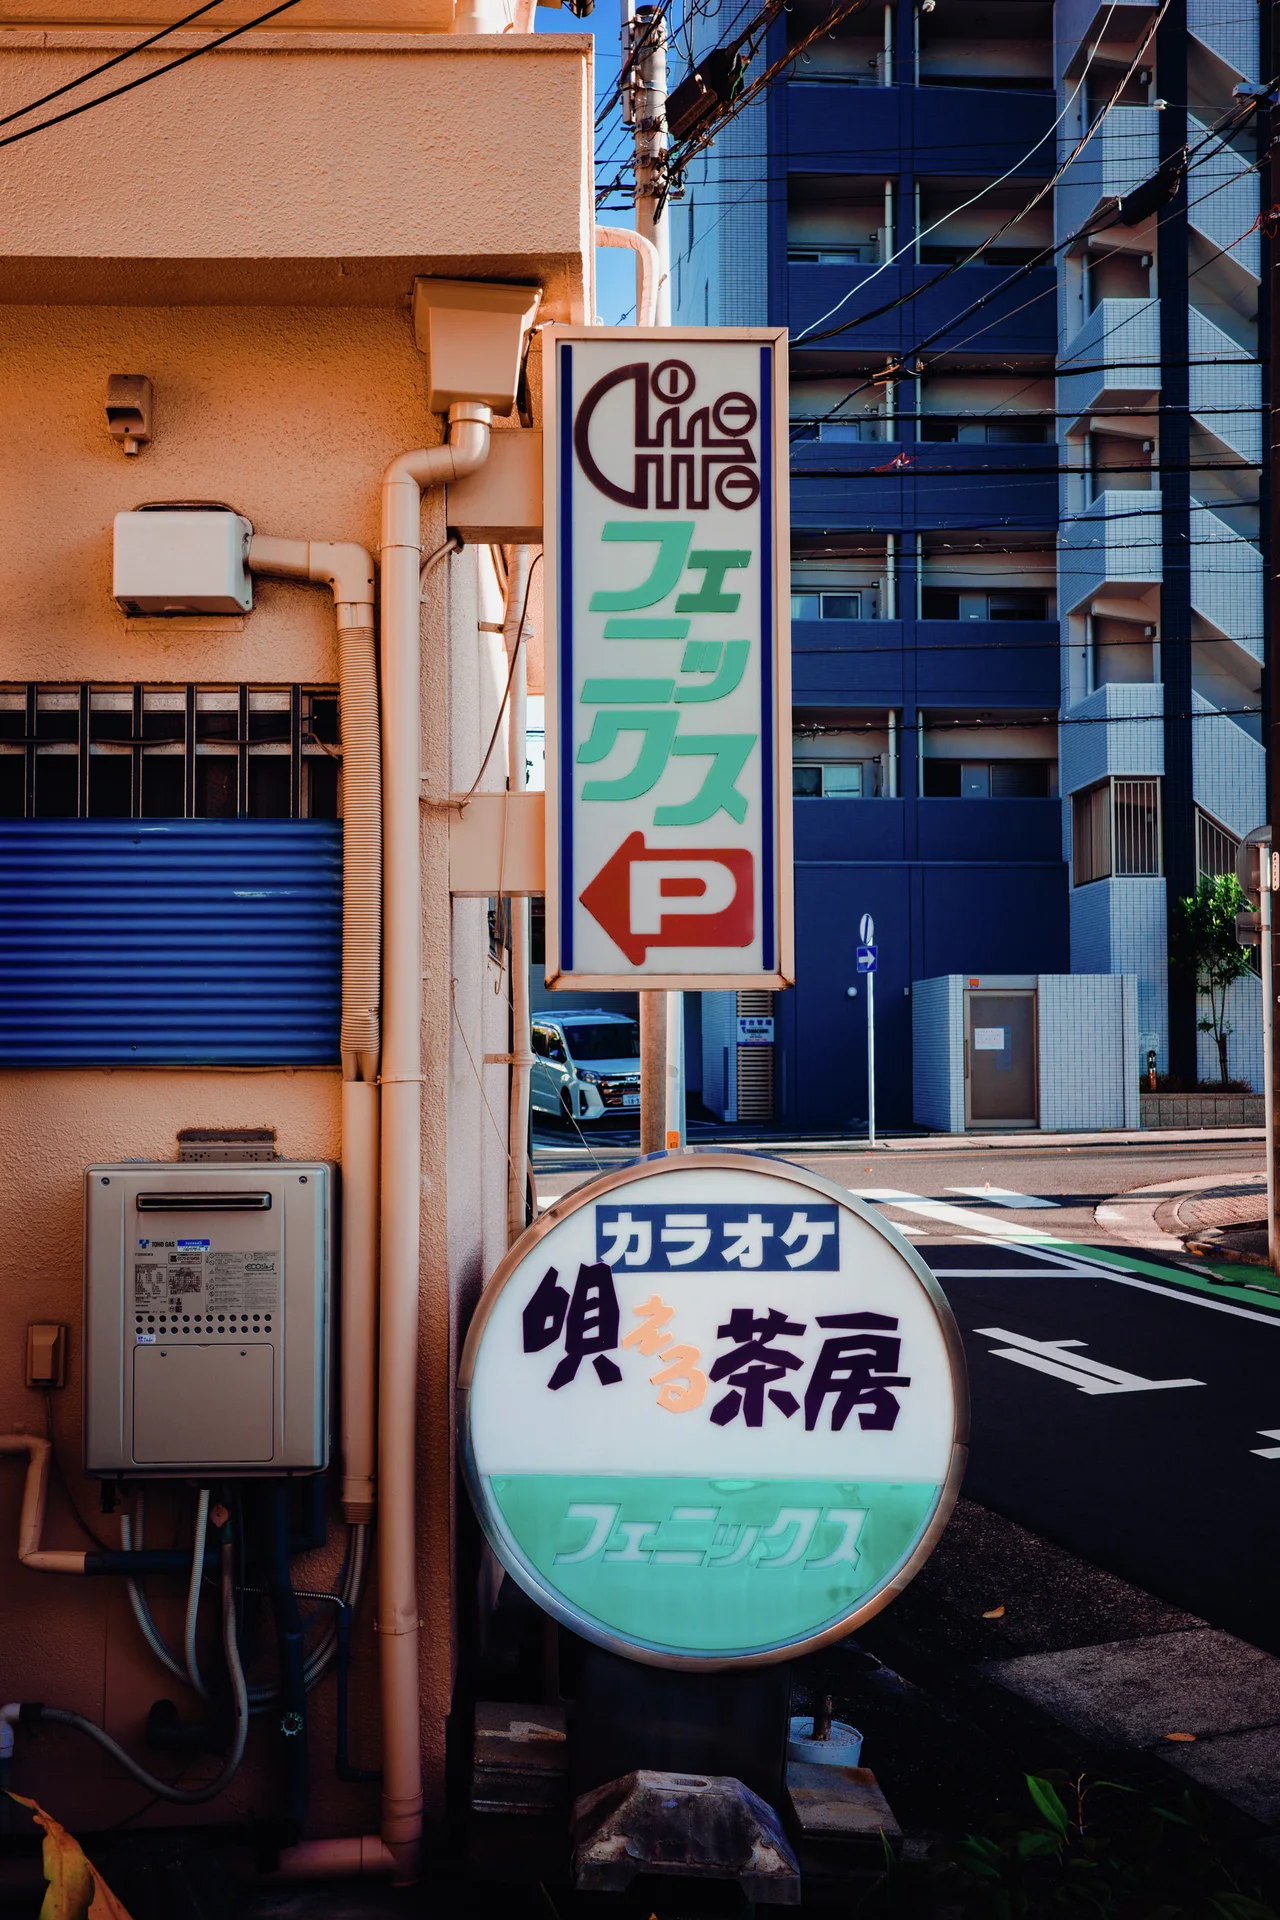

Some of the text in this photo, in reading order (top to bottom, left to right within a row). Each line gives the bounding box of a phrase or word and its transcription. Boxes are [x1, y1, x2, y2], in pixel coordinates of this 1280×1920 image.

[576, 521, 758, 826] フェニックス
[629, 860, 737, 935] P
[600, 1211, 836, 1268] カラオケ
[553, 1501, 870, 1571] フェニックス
